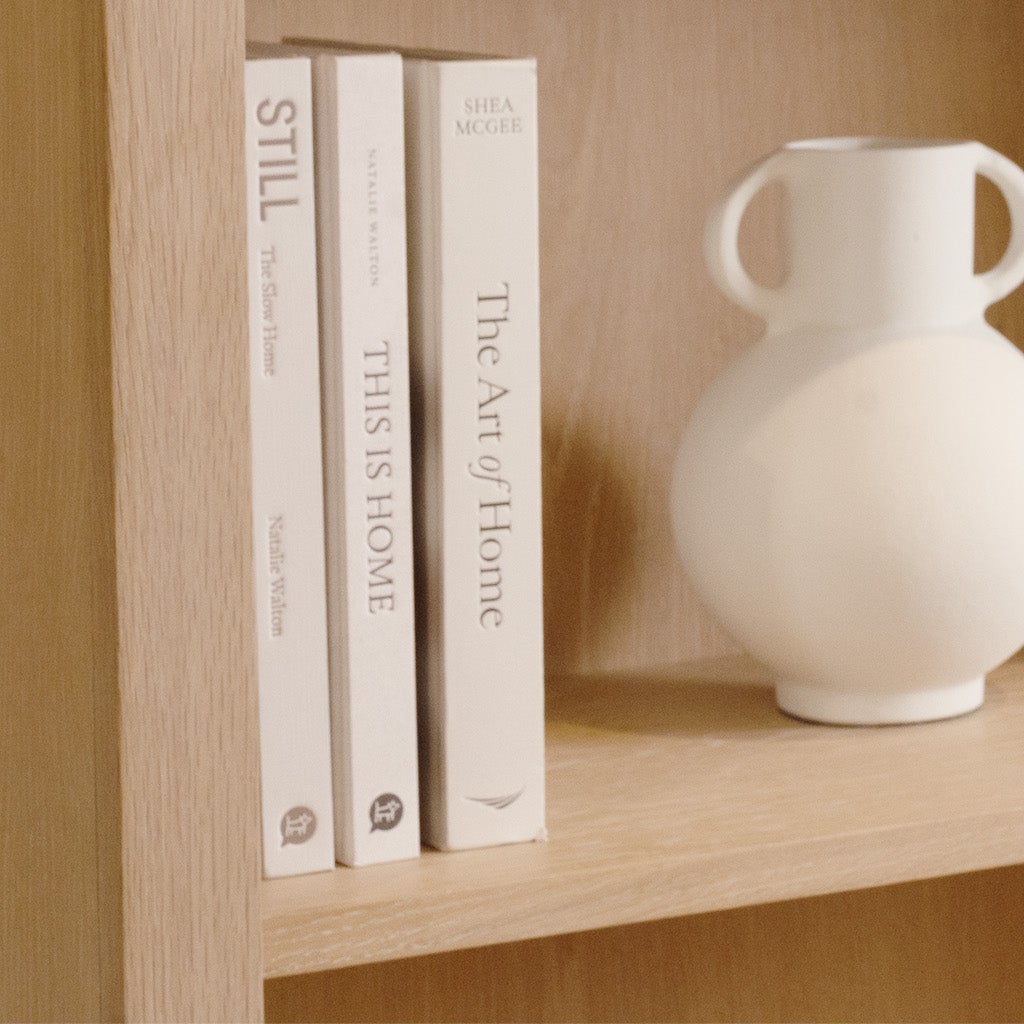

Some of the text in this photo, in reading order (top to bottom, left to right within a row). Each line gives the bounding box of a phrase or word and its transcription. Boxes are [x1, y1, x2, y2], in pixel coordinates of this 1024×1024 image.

[256, 97, 299, 222] STILL
[455, 118, 523, 137] MCGEE
[463, 97, 514, 116] SHEA
[367, 148, 380, 288] NATALIE WALTON
[260, 245, 279, 377] The Slow Home
[363, 340, 396, 616] THIS IS HOME
[468, 281, 512, 630] The Art of Home
[267, 515, 286, 638] Natalie Walton
